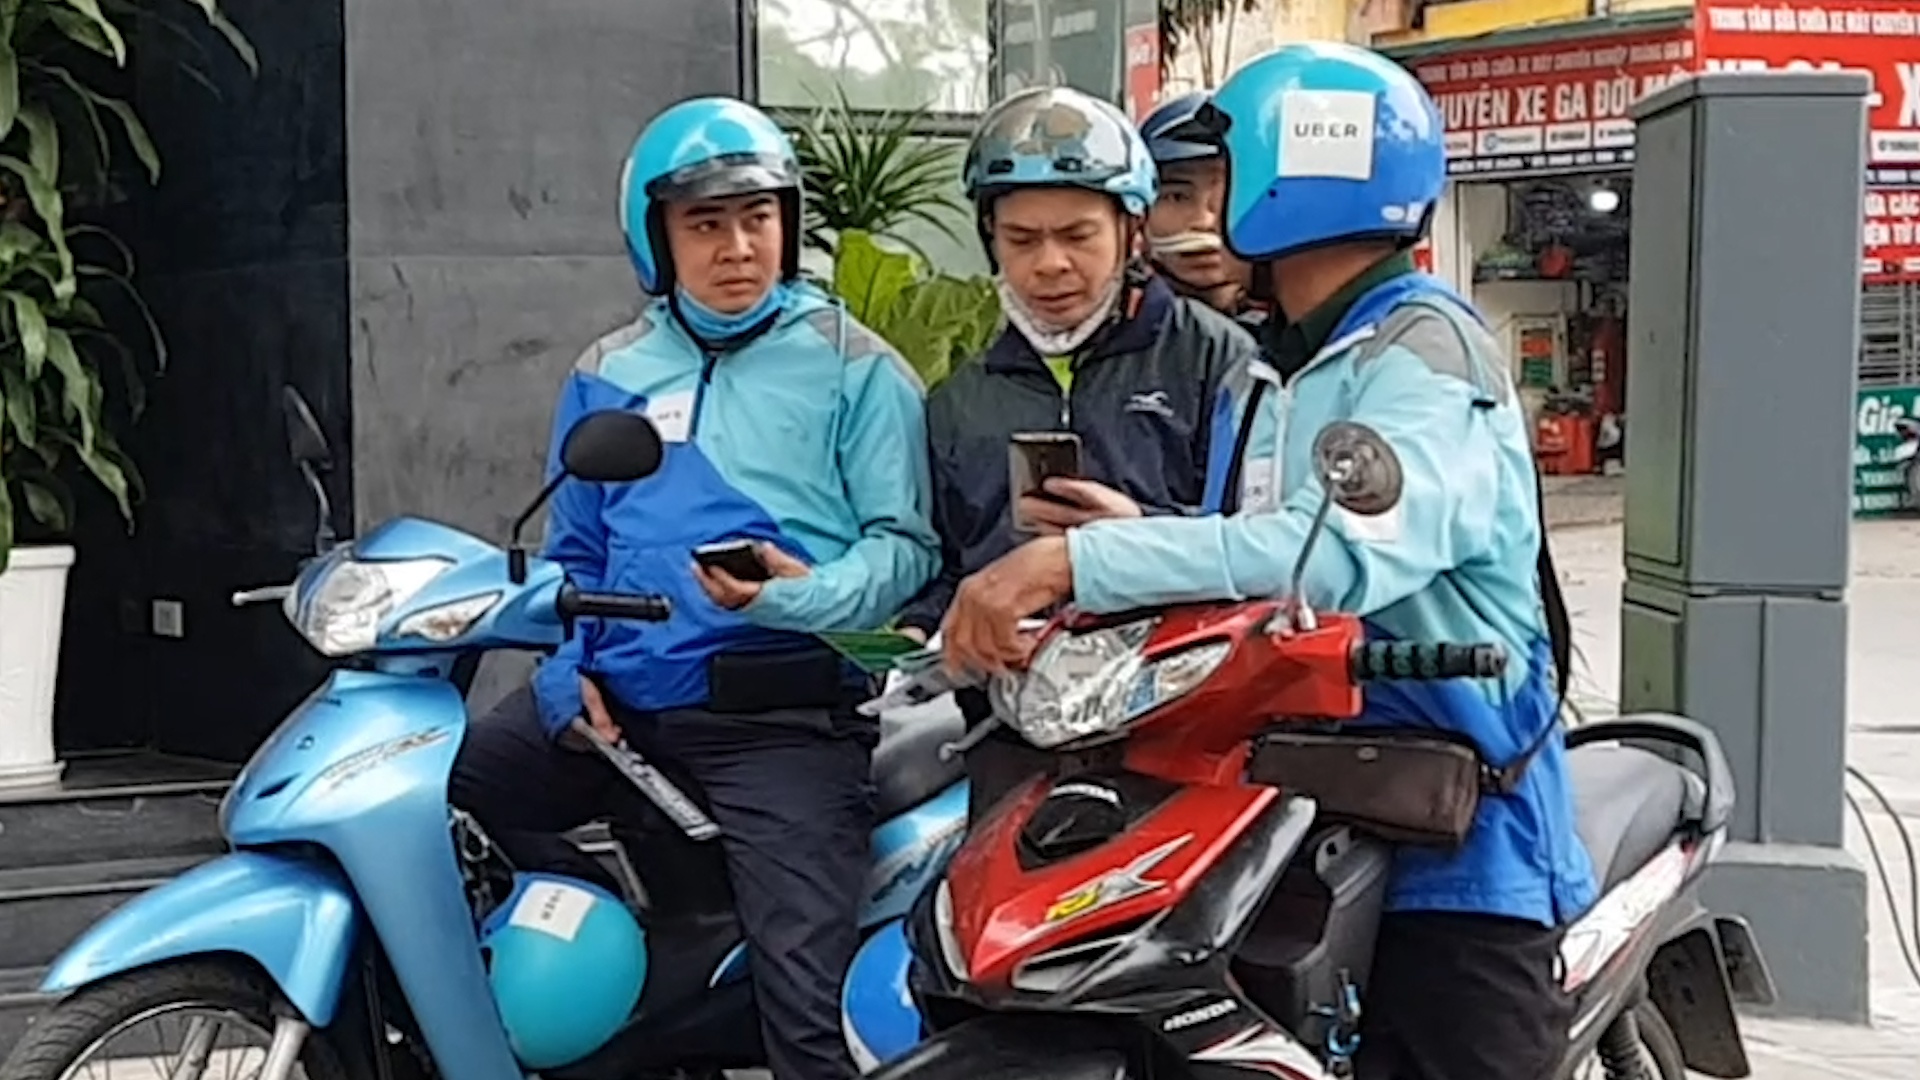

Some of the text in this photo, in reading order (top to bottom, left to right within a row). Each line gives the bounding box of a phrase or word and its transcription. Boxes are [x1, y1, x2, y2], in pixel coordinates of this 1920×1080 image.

[1515, 84, 1547, 124] XE
[1554, 81, 1586, 120] GA
[1294, 122, 1358, 138] UBER
[1163, 999, 1238, 1032] HONDA
